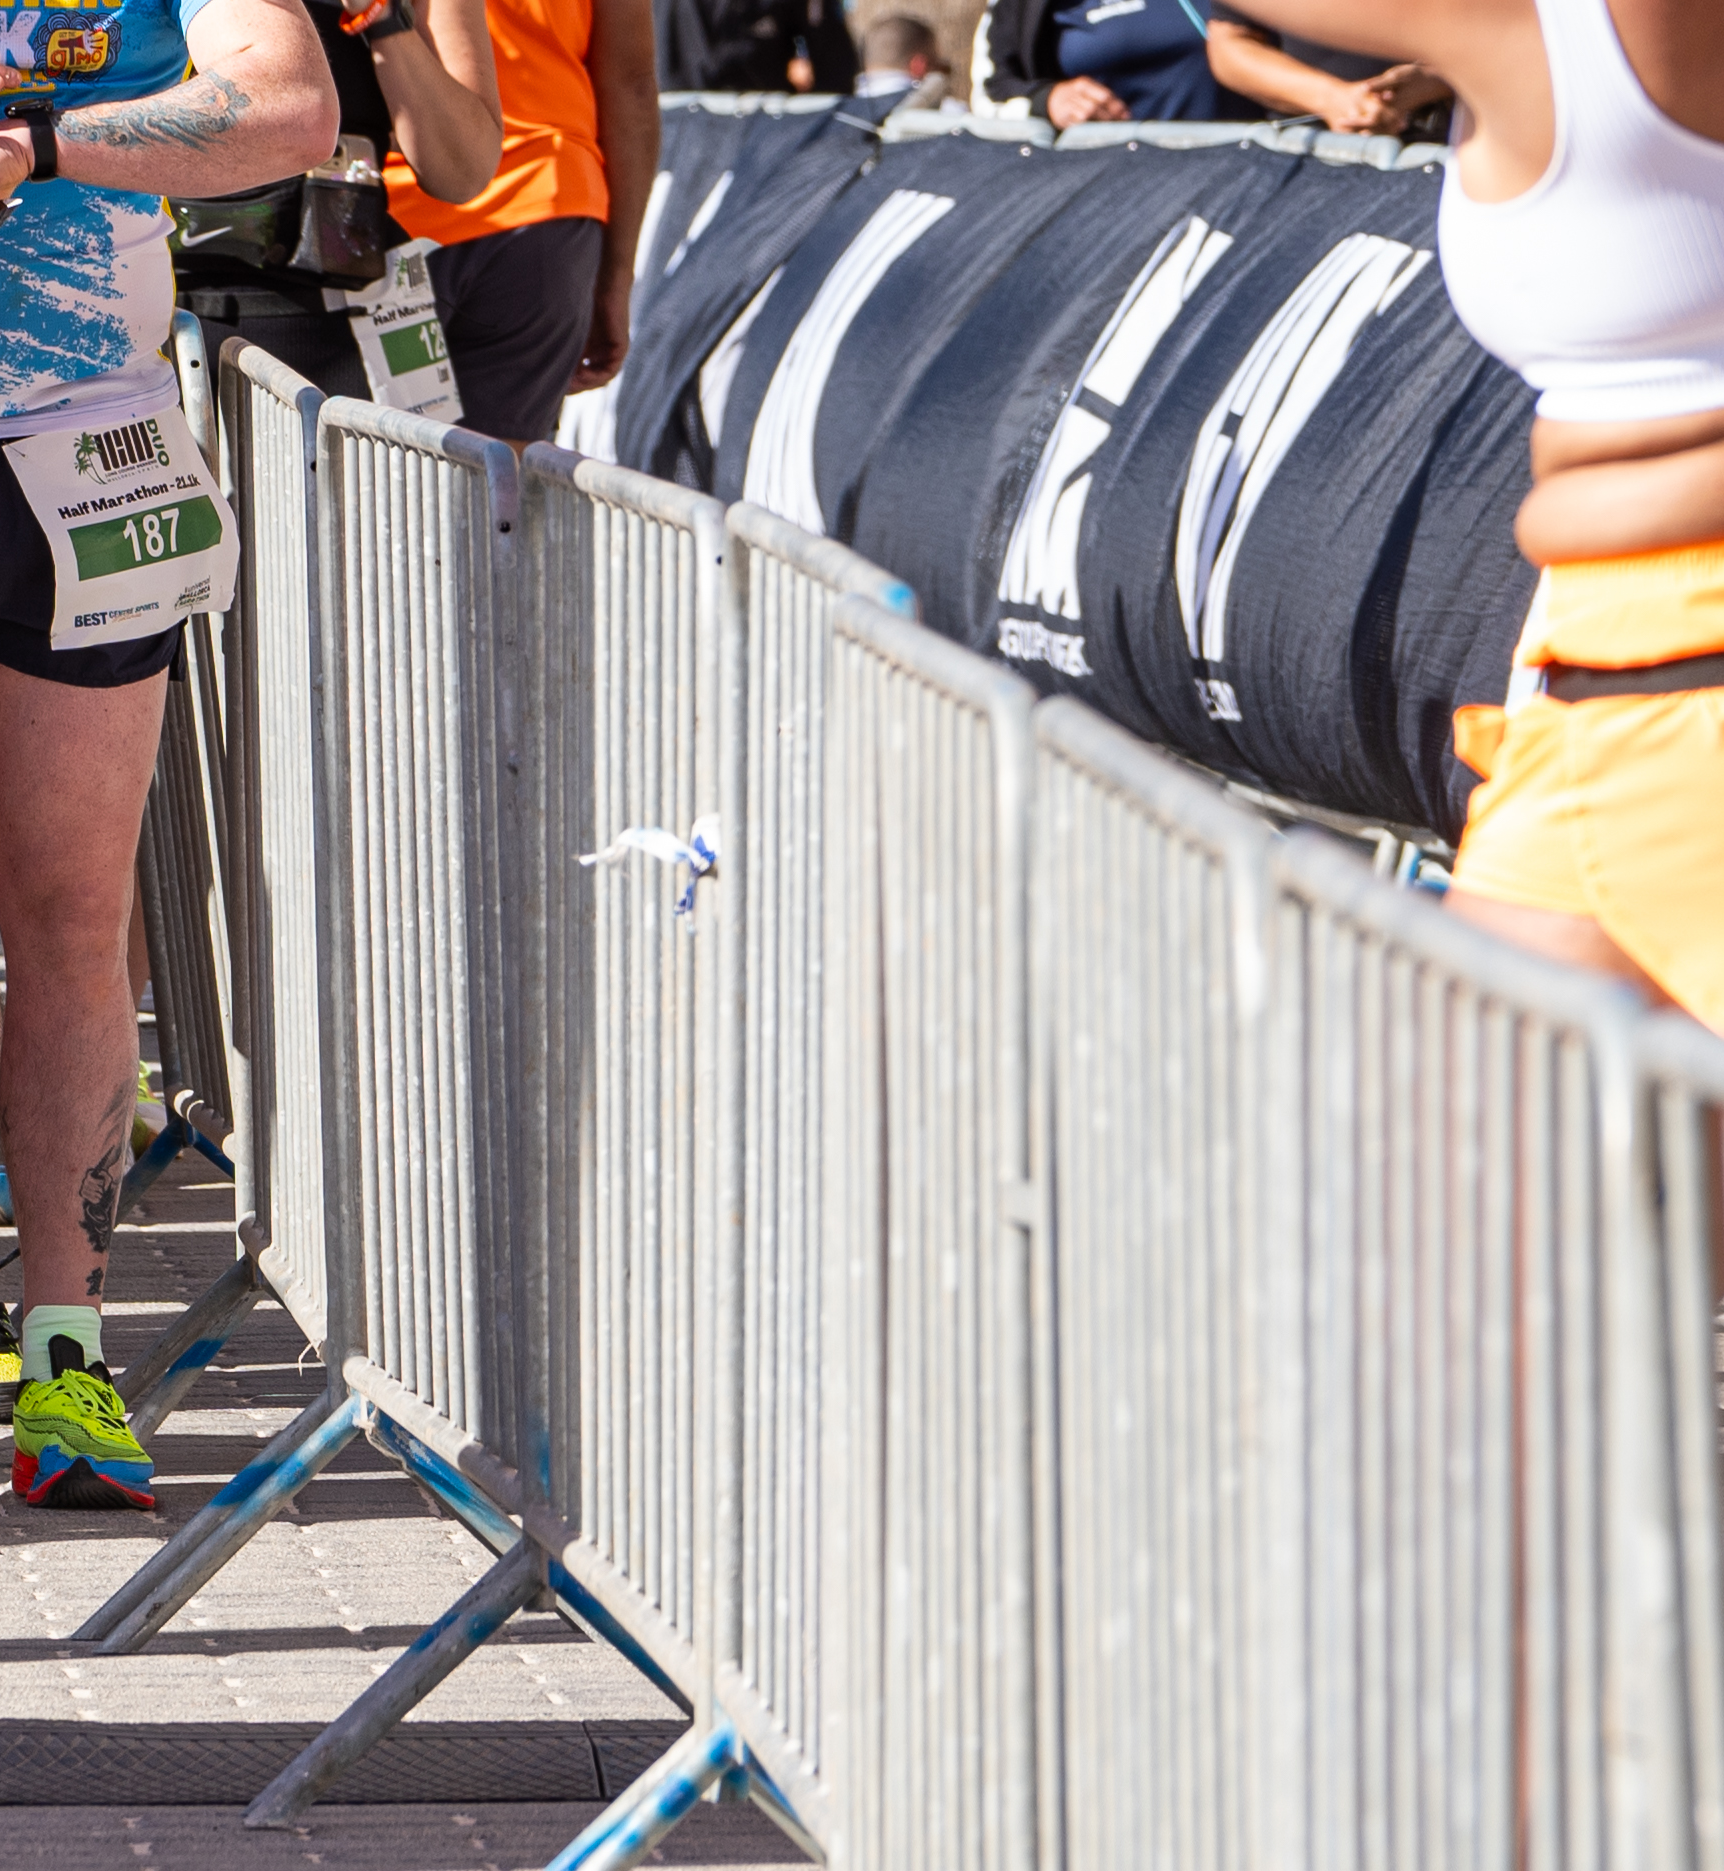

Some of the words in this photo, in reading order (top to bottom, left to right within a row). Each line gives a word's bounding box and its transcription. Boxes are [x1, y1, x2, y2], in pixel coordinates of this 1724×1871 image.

[373, 309, 397, 326] Half
[145, 418, 170, 467] DUO
[58, 502, 90, 520] Half
[93, 481, 170, 512] Marathon
[175, 474, 201, 490] 21.1k
[123, 507, 180, 562] 187
[74, 612, 108, 628] BEST
[135, 602, 160, 615] SPORTS
